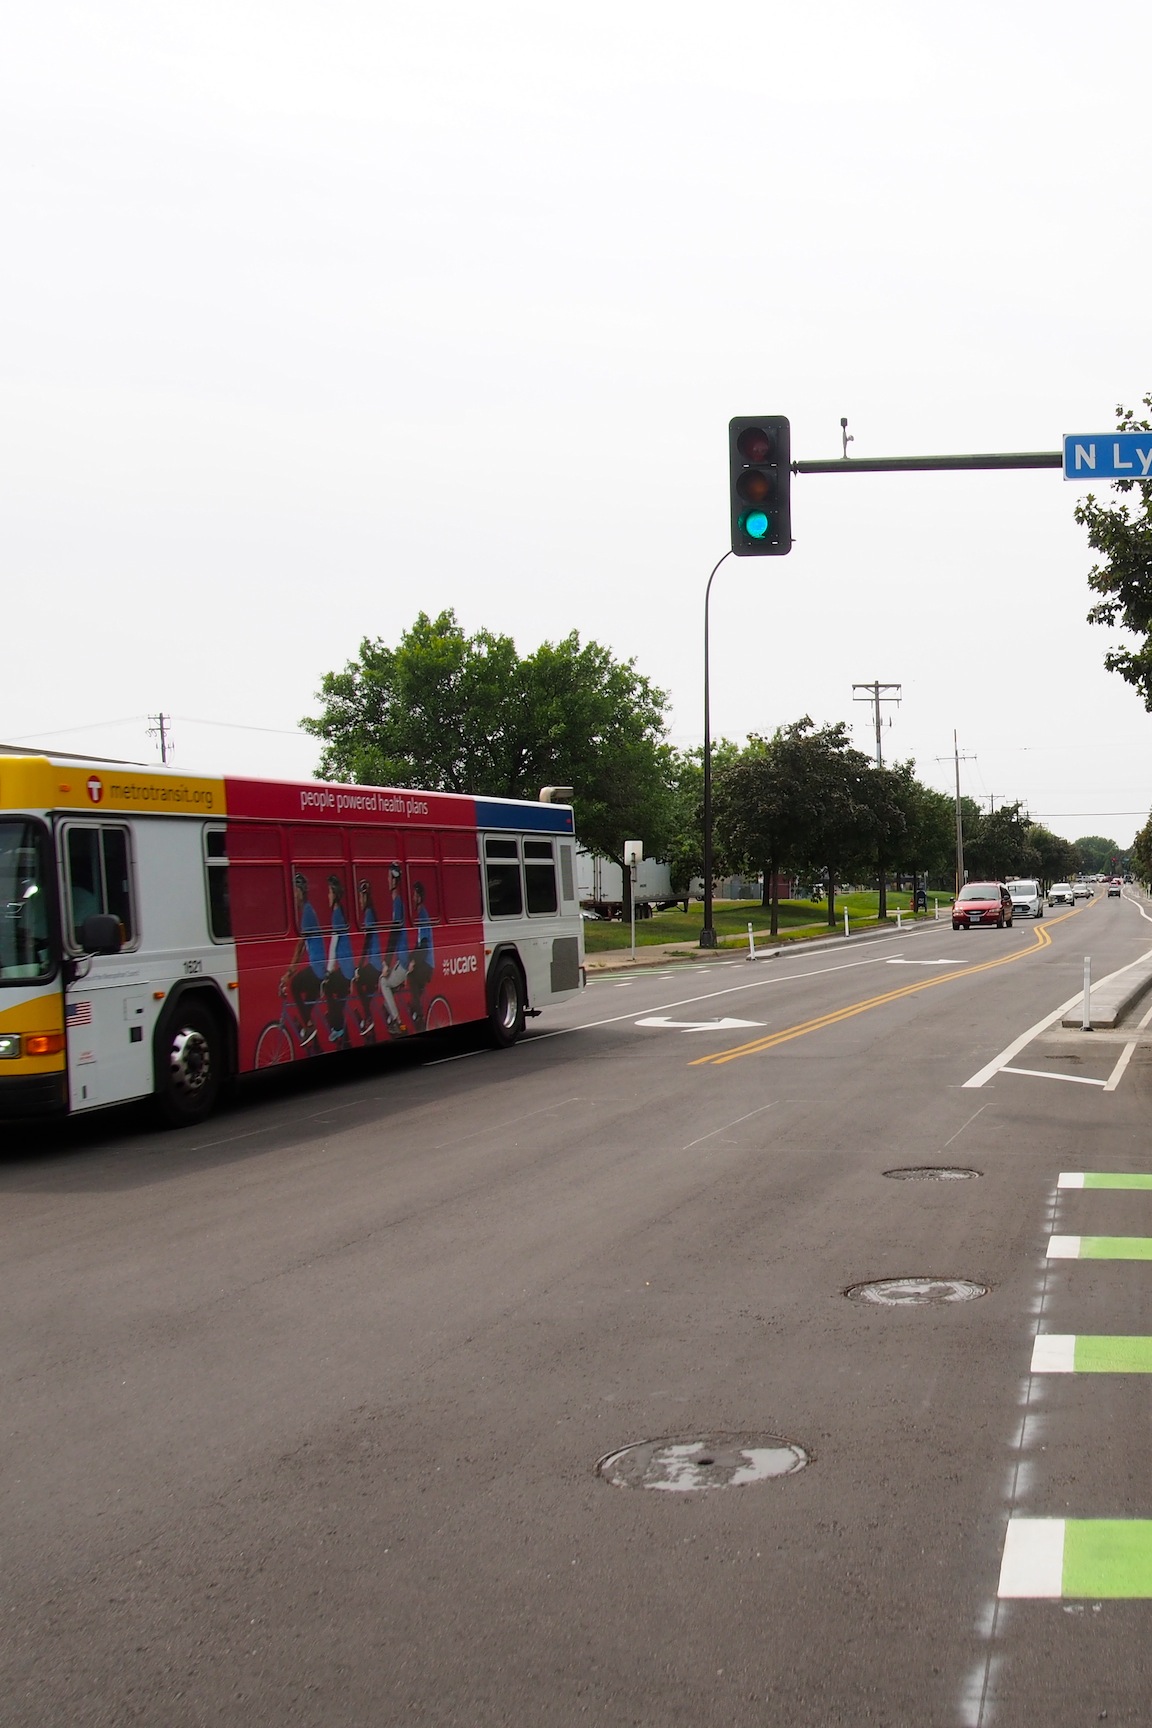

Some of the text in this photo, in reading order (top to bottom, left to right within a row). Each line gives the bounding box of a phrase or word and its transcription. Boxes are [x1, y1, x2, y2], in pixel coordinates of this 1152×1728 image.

[1075, 444, 1096, 470] N
[110, 784, 213, 809] metrotransit.org
[300, 789, 428, 818] people powered health plans
[183, 960, 202, 975] 1621
